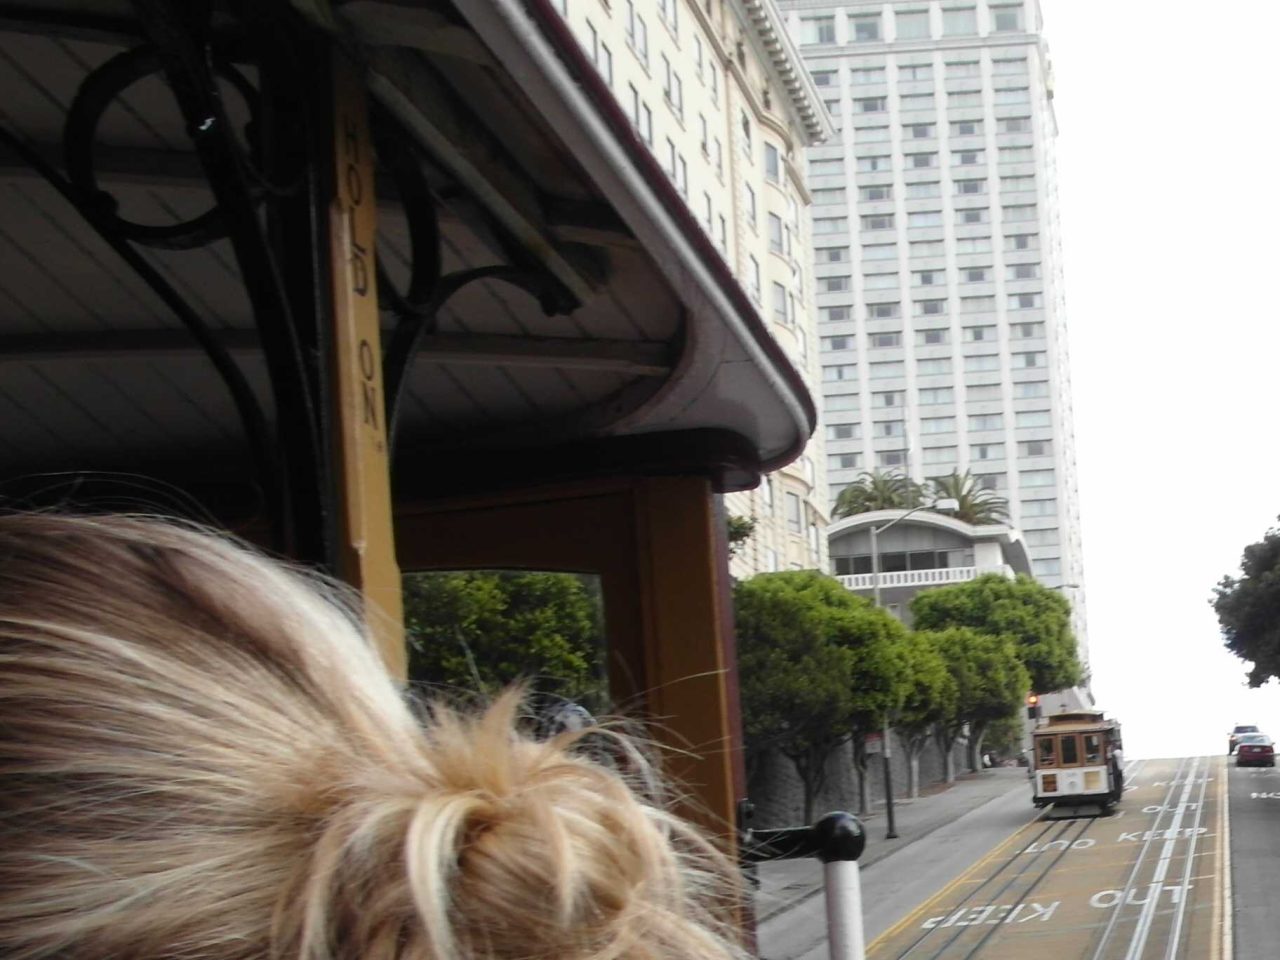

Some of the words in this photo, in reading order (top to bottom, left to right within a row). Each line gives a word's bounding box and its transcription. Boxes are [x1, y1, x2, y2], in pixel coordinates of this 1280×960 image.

[342, 113, 367, 297] HOLD
[360, 338, 380, 431] ON
[1015, 838, 1097, 854] OUT
[1117, 828, 1208, 842] KEEP
[1089, 885, 1194, 908] OUT
[921, 901, 1061, 929] KEEP
